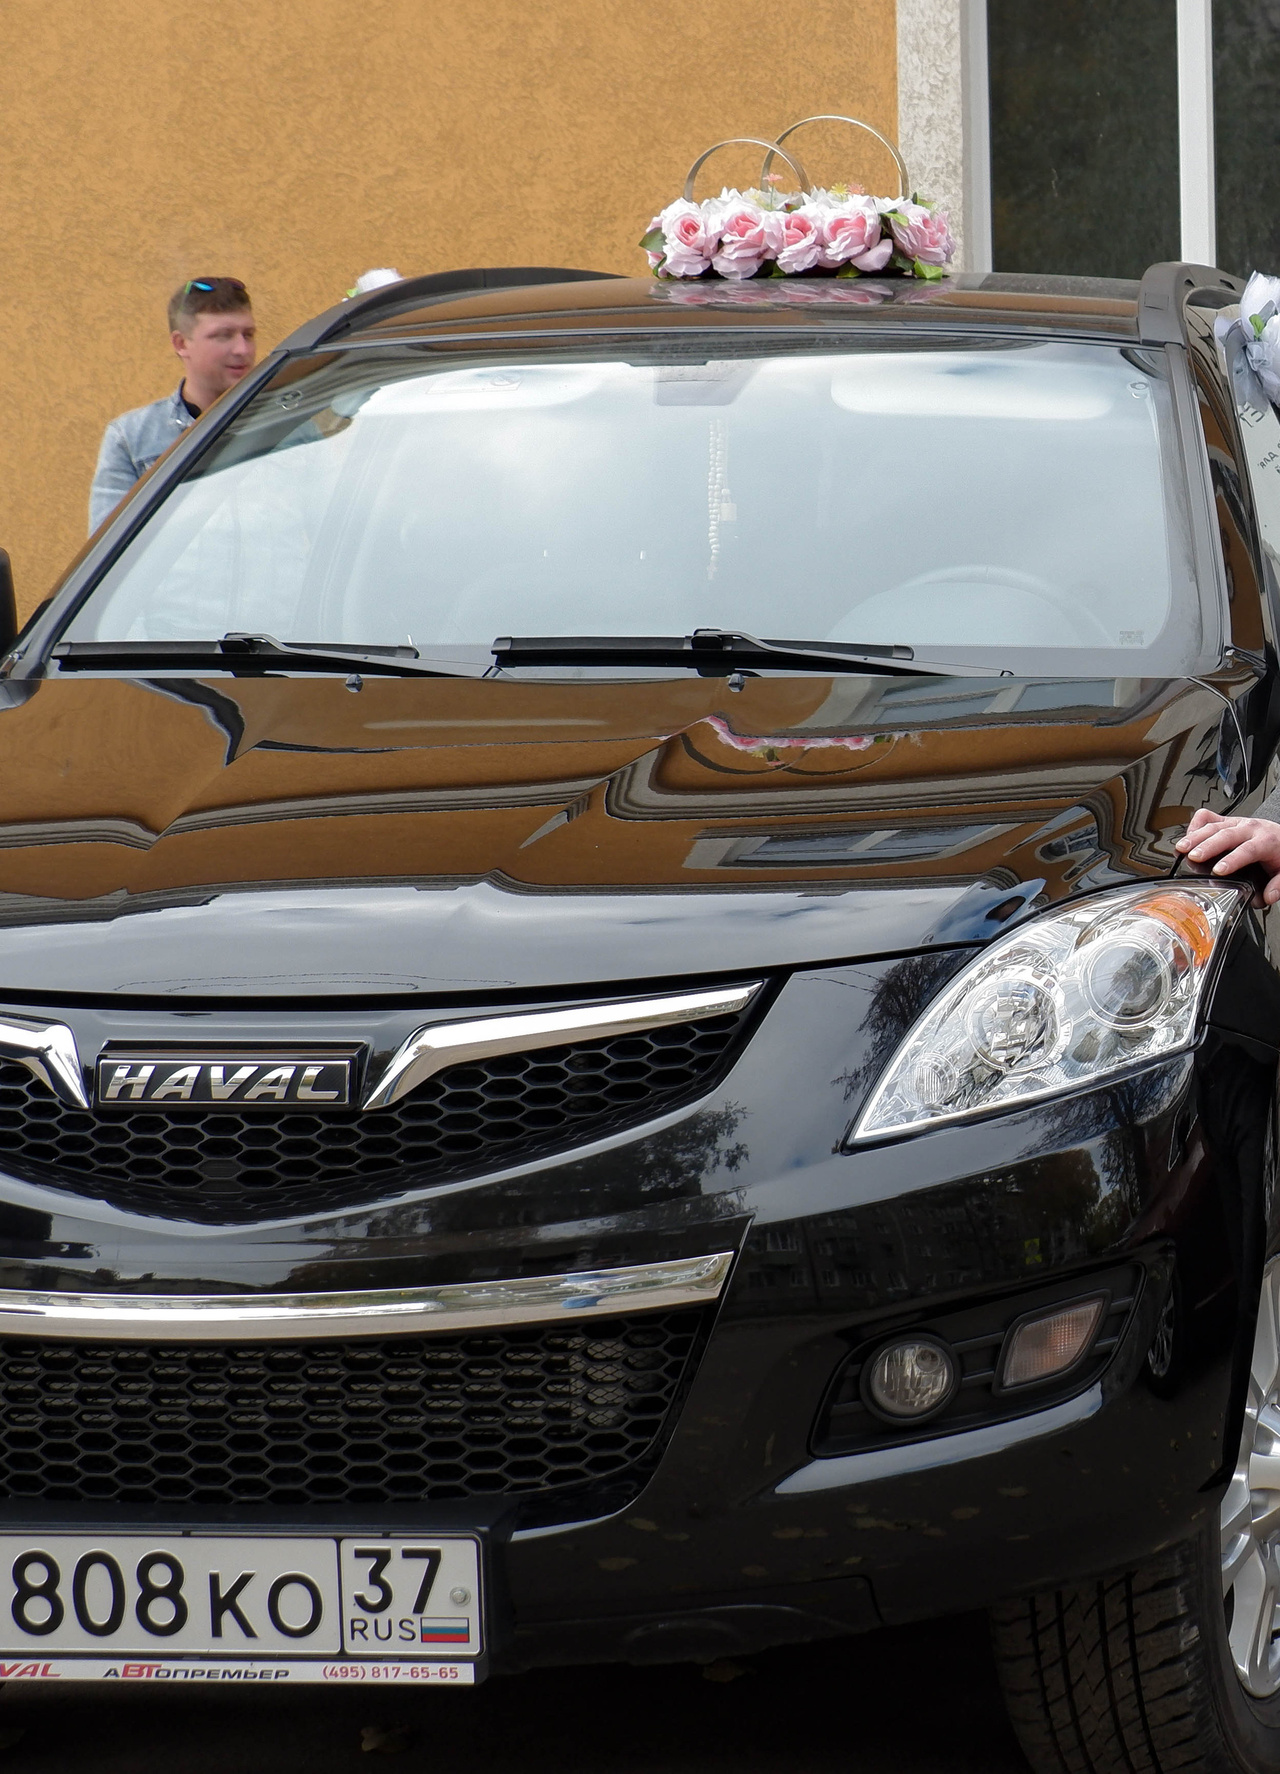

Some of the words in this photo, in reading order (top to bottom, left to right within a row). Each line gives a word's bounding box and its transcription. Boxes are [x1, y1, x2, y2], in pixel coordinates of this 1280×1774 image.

[105, 1065, 340, 1100] HAVAL
[353, 1546, 442, 1614] 37
[350, 1618, 416, 1641] RUS
[322, 1665, 366, 1680] (495)
[371, 1666, 459, 1679] 817-65-65
